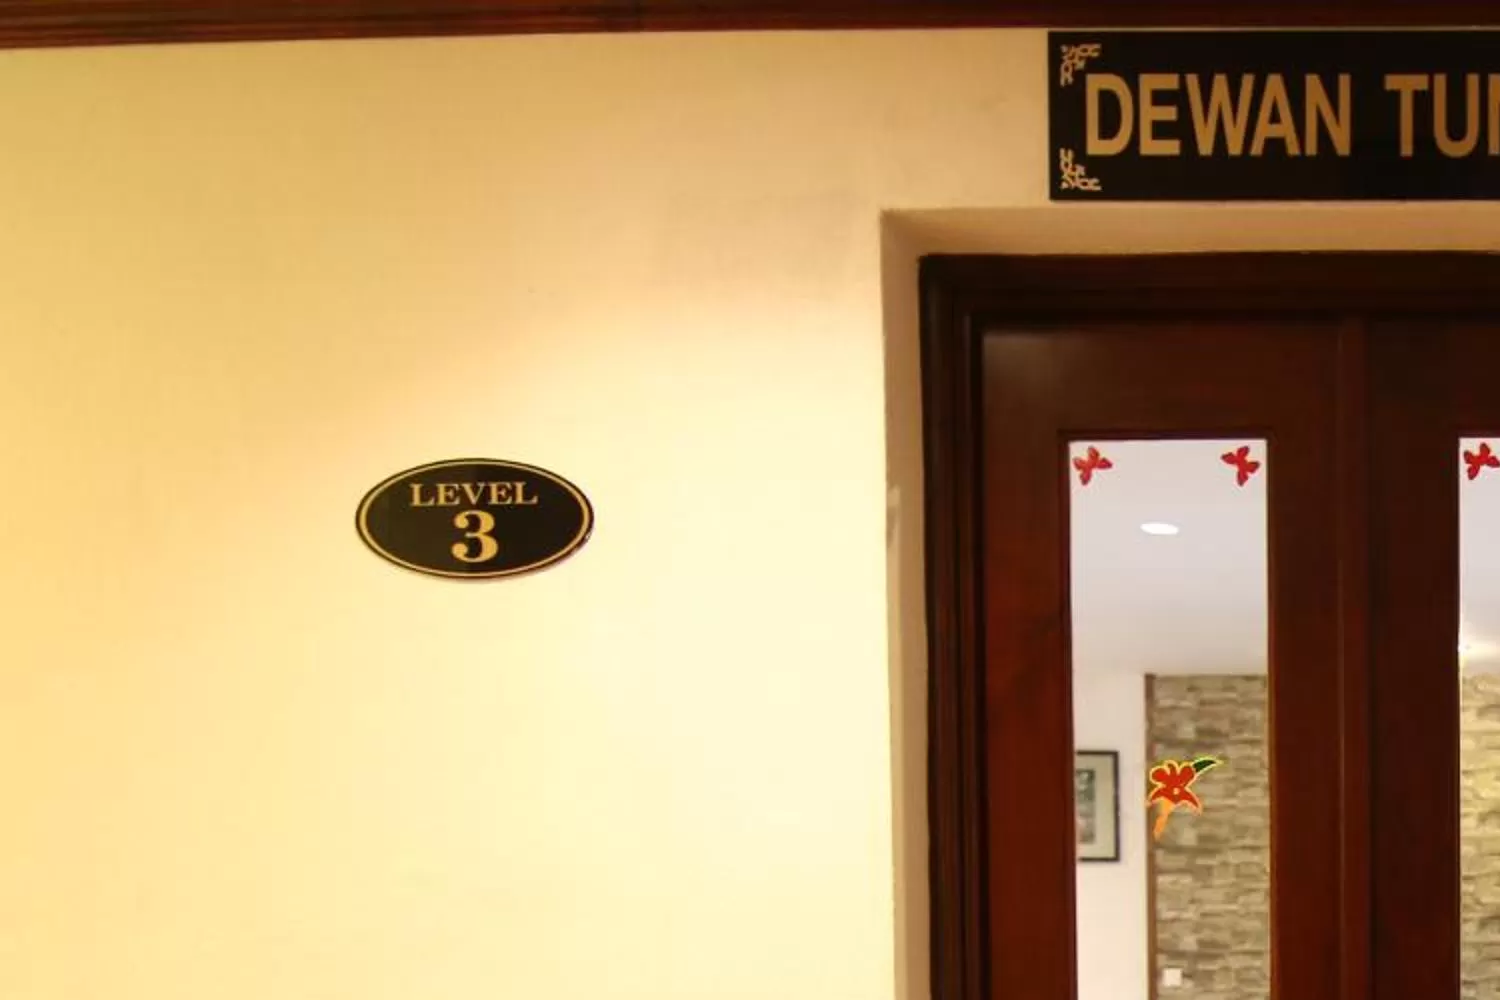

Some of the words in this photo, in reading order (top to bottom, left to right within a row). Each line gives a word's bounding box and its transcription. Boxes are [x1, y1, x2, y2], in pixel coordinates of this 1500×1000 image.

[1085, 73, 1352, 157] DEWAN
[410, 481, 539, 507] LEVEL
[452, 510, 498, 563] 3
